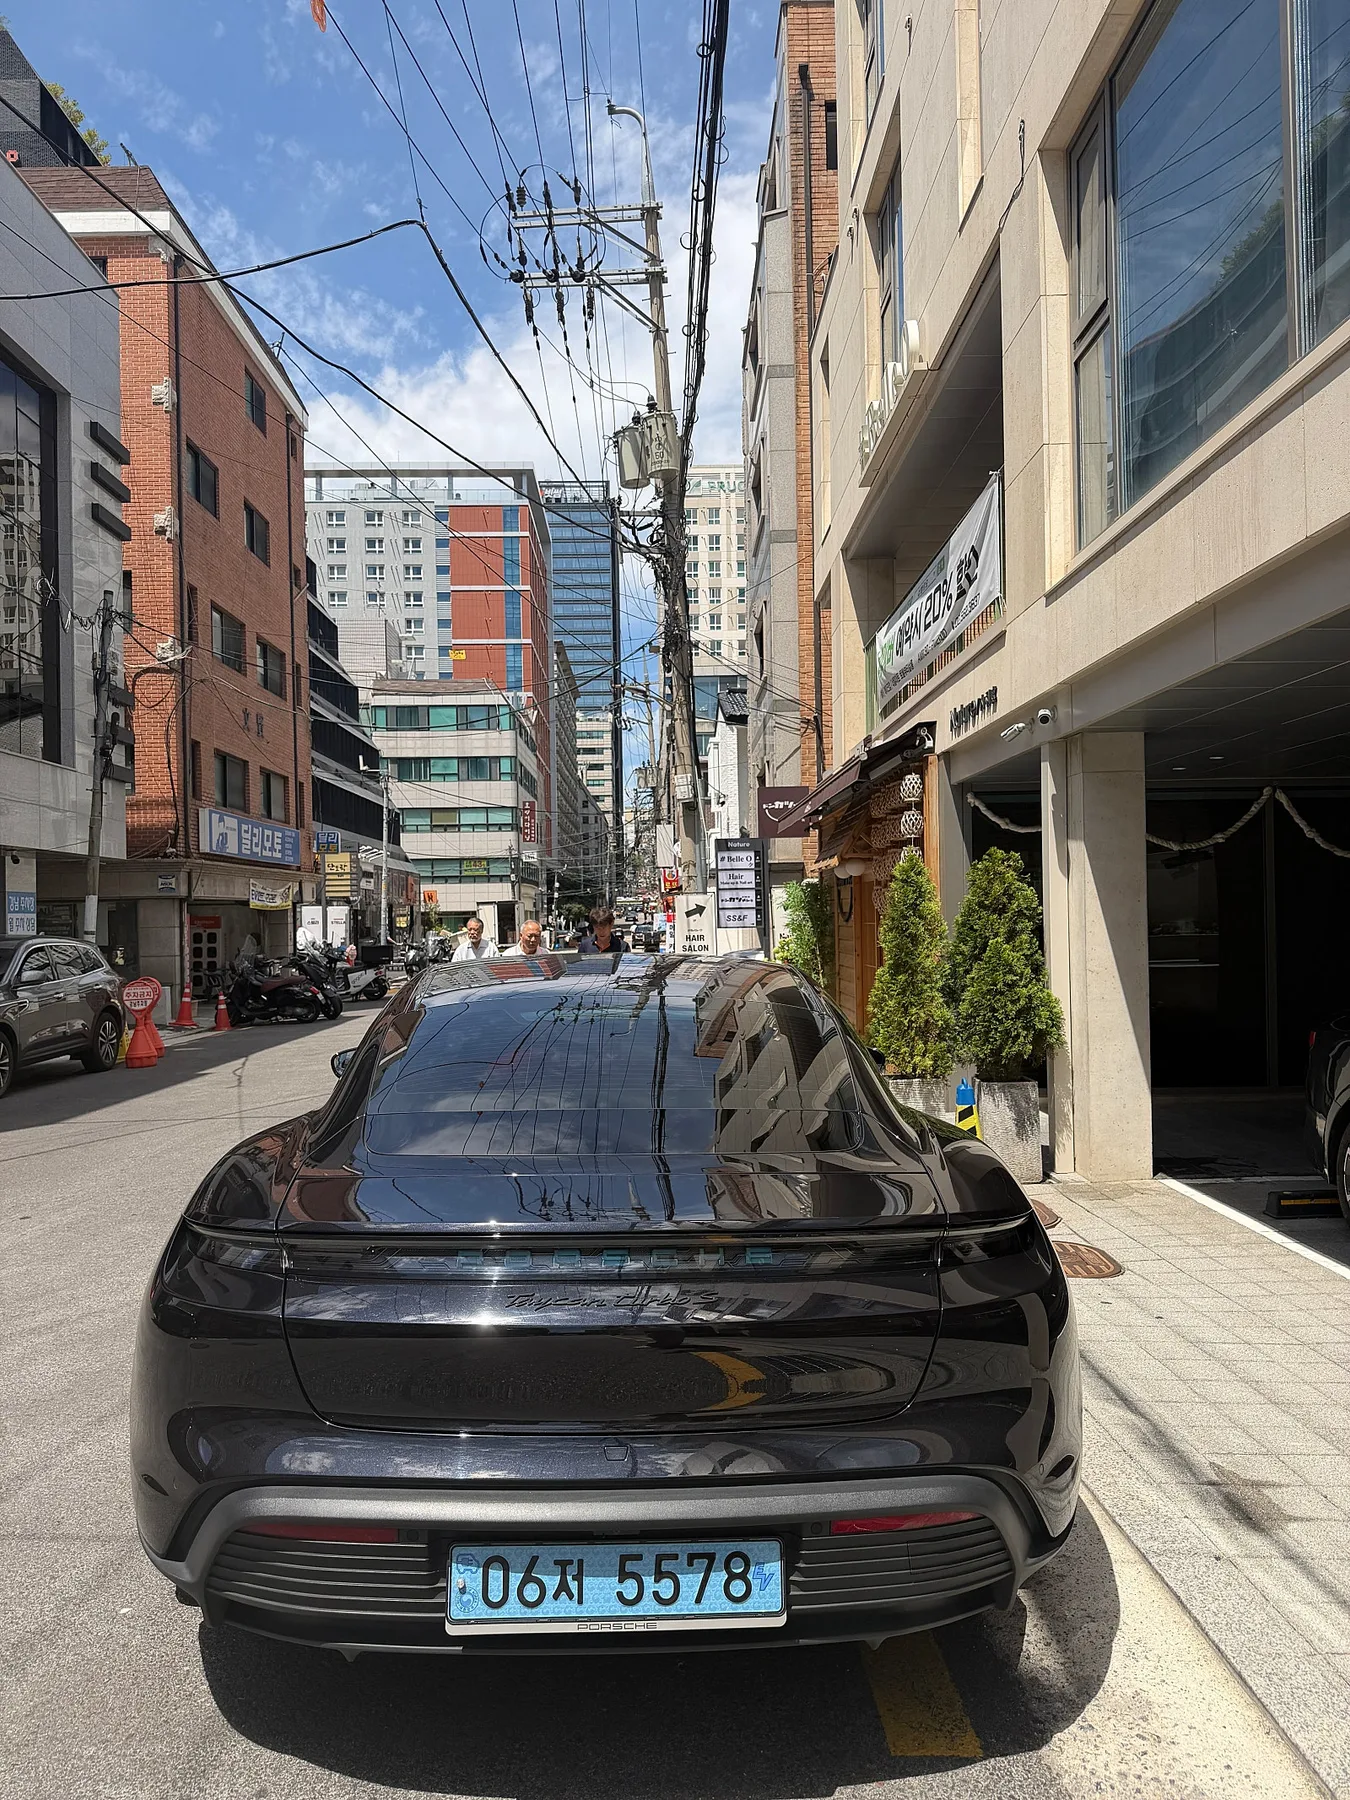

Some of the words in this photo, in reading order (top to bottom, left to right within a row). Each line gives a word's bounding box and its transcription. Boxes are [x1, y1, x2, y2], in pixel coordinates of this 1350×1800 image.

[896, 601, 924, 657] 예약시
[923, 571, 954, 632] 20%
[241, 823, 282, 858] 딜리모토
[727, 855, 744, 863] Belle
[726, 914, 748, 922] SS&F
[685, 934, 705, 942] HAIR
[681, 944, 709, 952] SALON
[456, 1246, 773, 1268] PORSCHE
[506, 1292, 607, 1312] Taycan
[692, 1291, 720, 1305] S
[481, 1553, 584, 1609] 06저
[616, 1550, 753, 1607] 5578
[577, 1621, 658, 1632] PORSCHE
